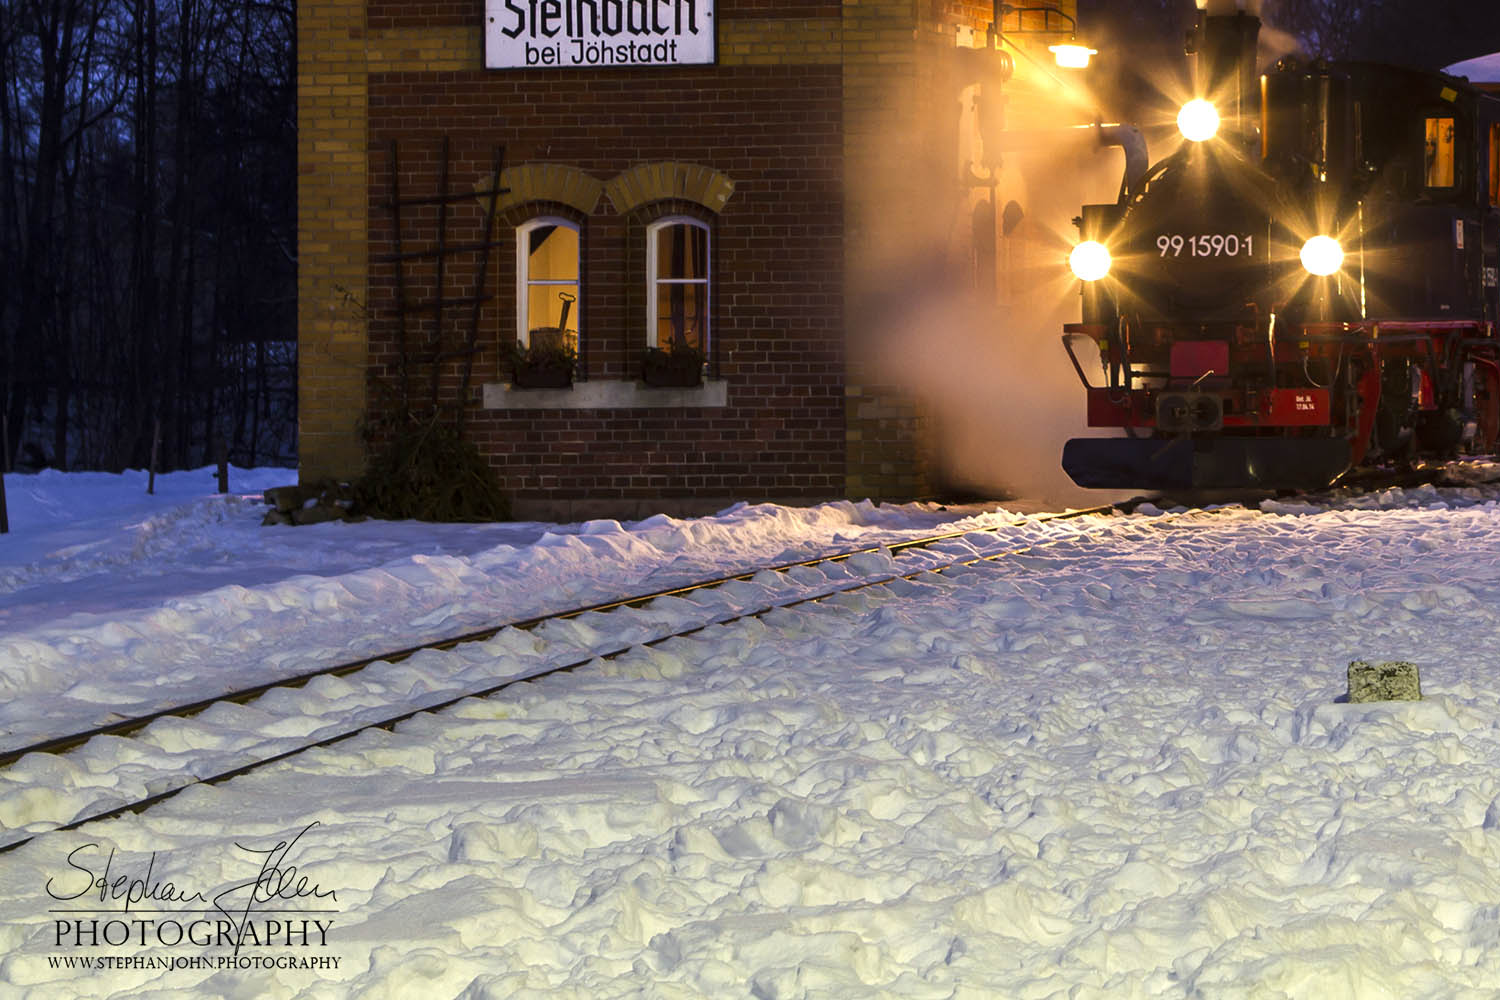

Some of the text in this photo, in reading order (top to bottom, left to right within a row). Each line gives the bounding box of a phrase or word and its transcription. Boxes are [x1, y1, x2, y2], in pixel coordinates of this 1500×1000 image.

[525, 39, 677, 65] bei Jöhstadt
[1156, 234, 1184, 257] 99
